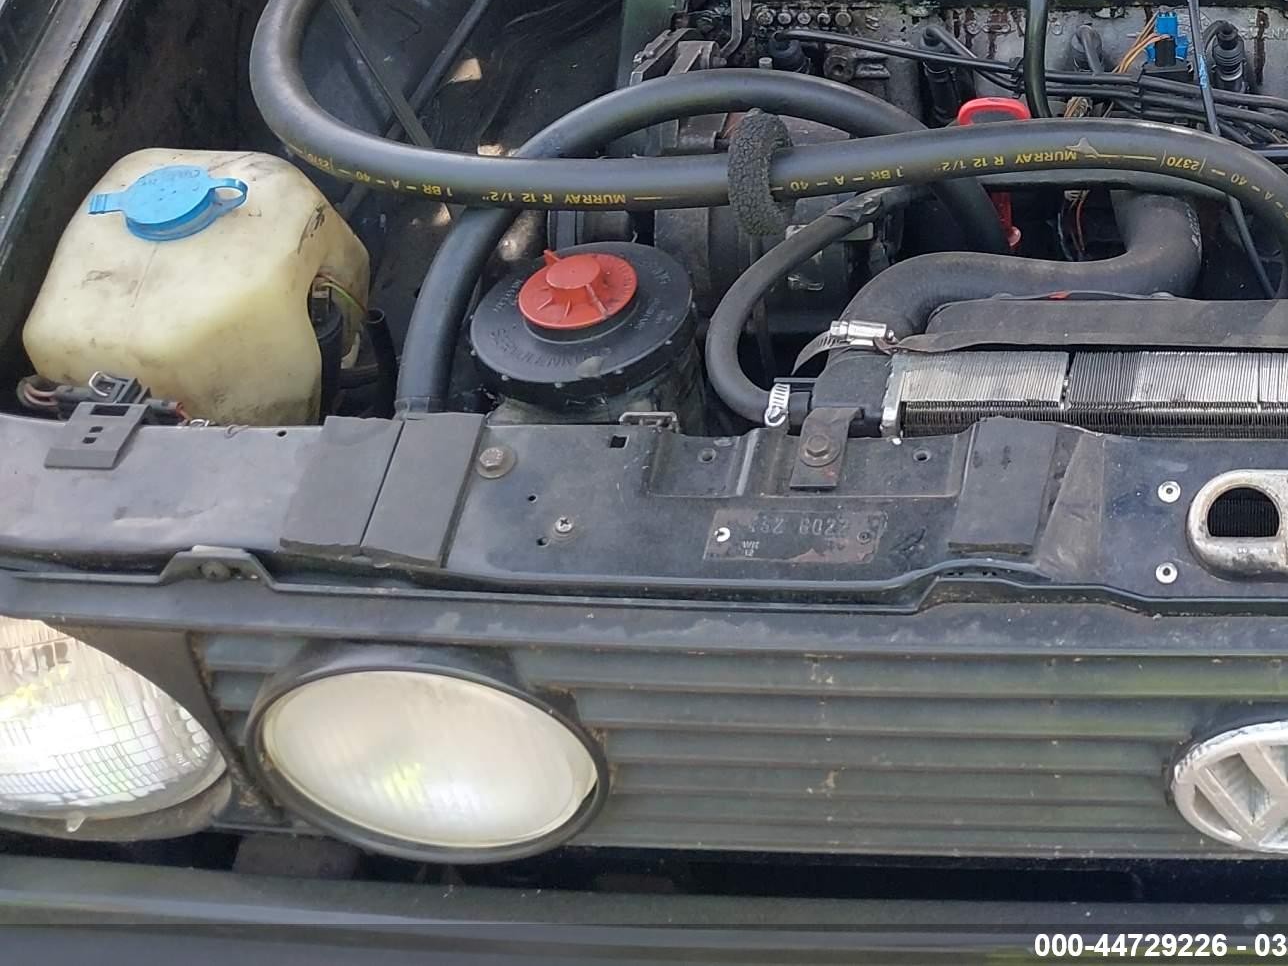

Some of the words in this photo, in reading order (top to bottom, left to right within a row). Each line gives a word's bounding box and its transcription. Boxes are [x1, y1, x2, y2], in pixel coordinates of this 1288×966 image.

[973, 157, 988, 168] 12
[994, 156, 1004, 166] R
[1014, 150, 1077, 165] MURRAY
[390, 180, 400, 189] A
[833, 175, 845, 185] A
[1230, 172, 1248, 186] 40
[422, 184, 442, 196] BR
[790, 181, 809, 192] 40
[521, 192, 536, 203] 12
[543, 193, 552, 204] R
[564, 193, 626, 204] MURRAY
